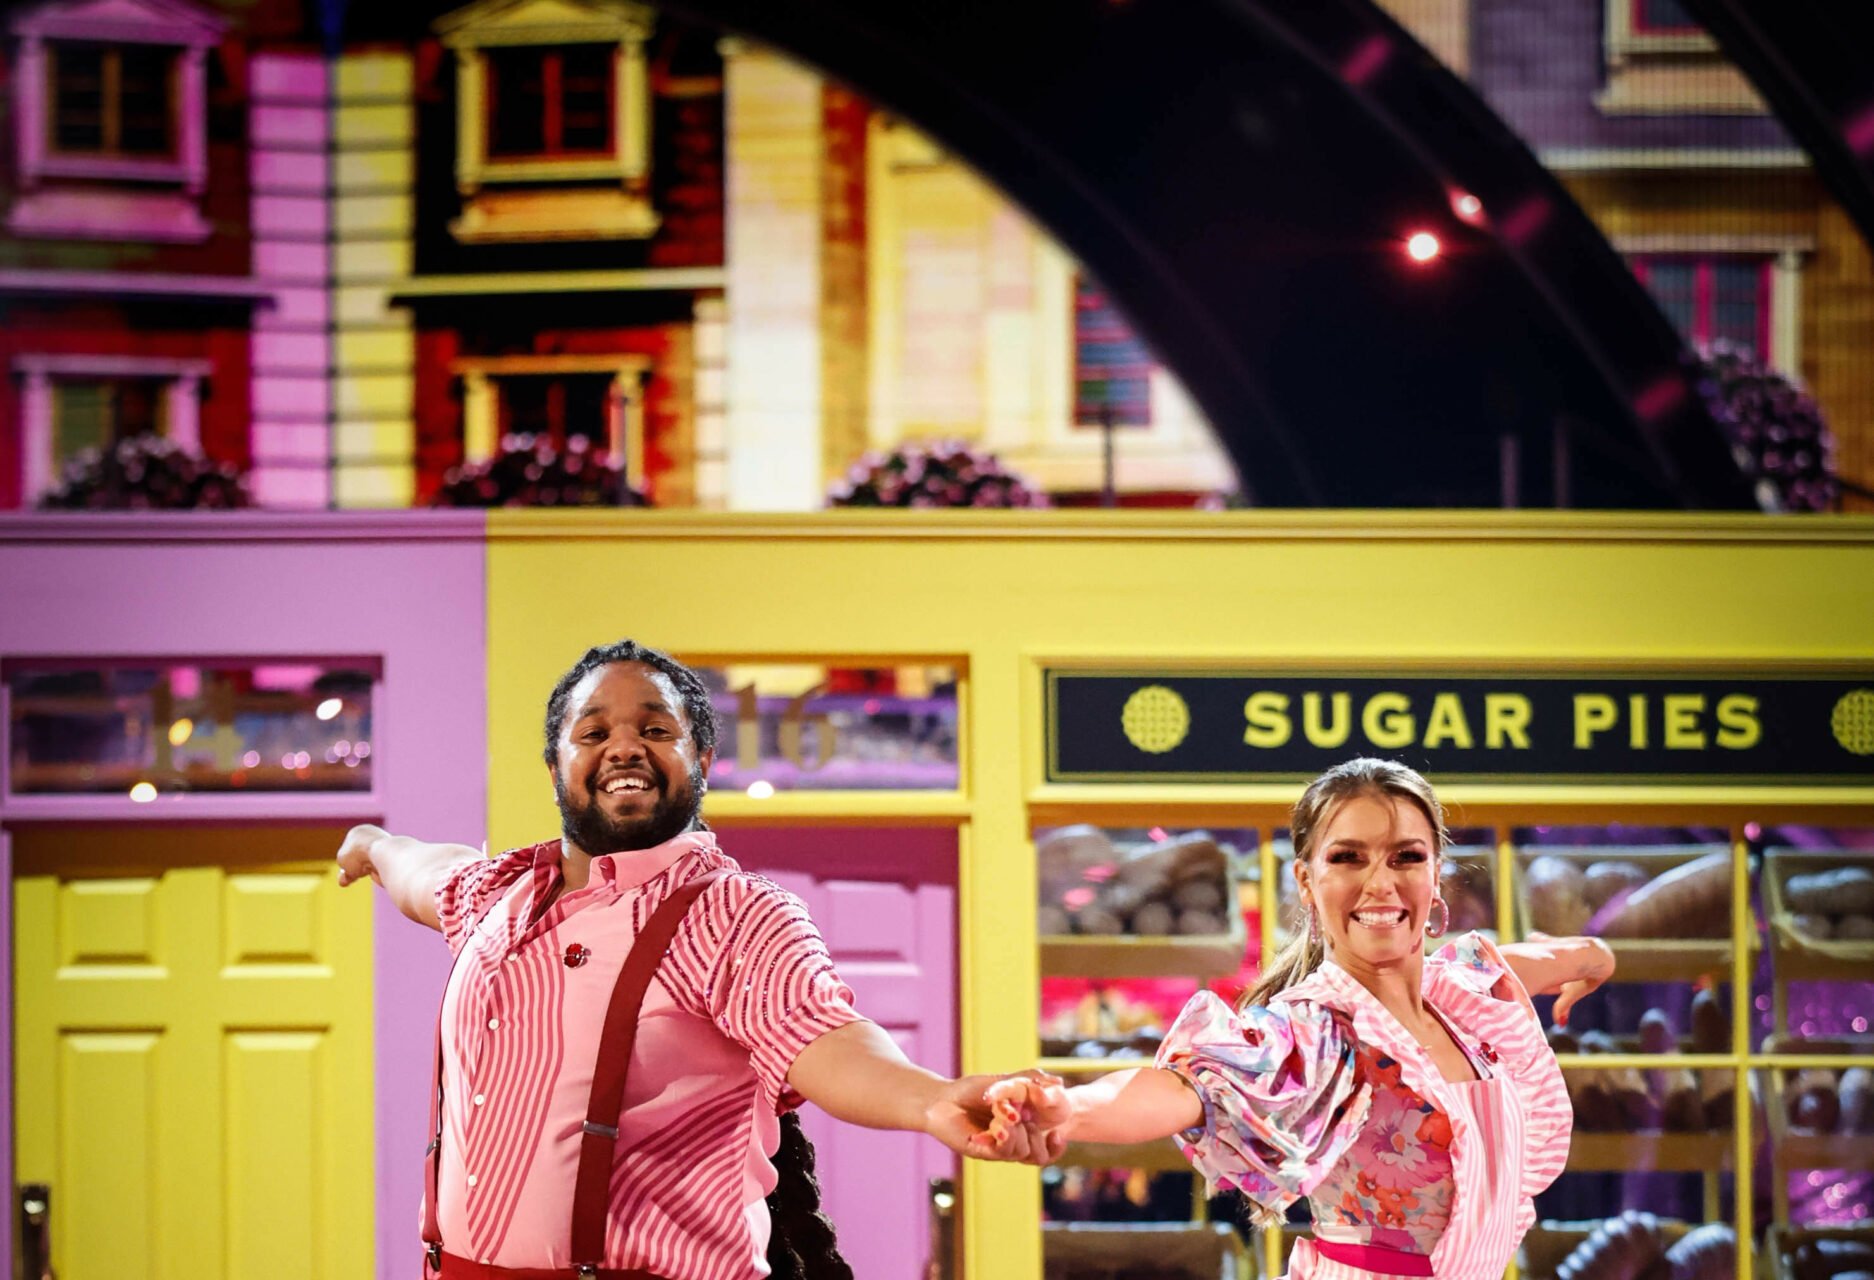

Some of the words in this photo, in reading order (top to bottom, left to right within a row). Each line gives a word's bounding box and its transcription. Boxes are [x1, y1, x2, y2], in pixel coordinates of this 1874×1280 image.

[732, 681, 836, 771] 16
[1243, 692, 1532, 750] SUGAR
[1574, 693, 1762, 750] PIES
